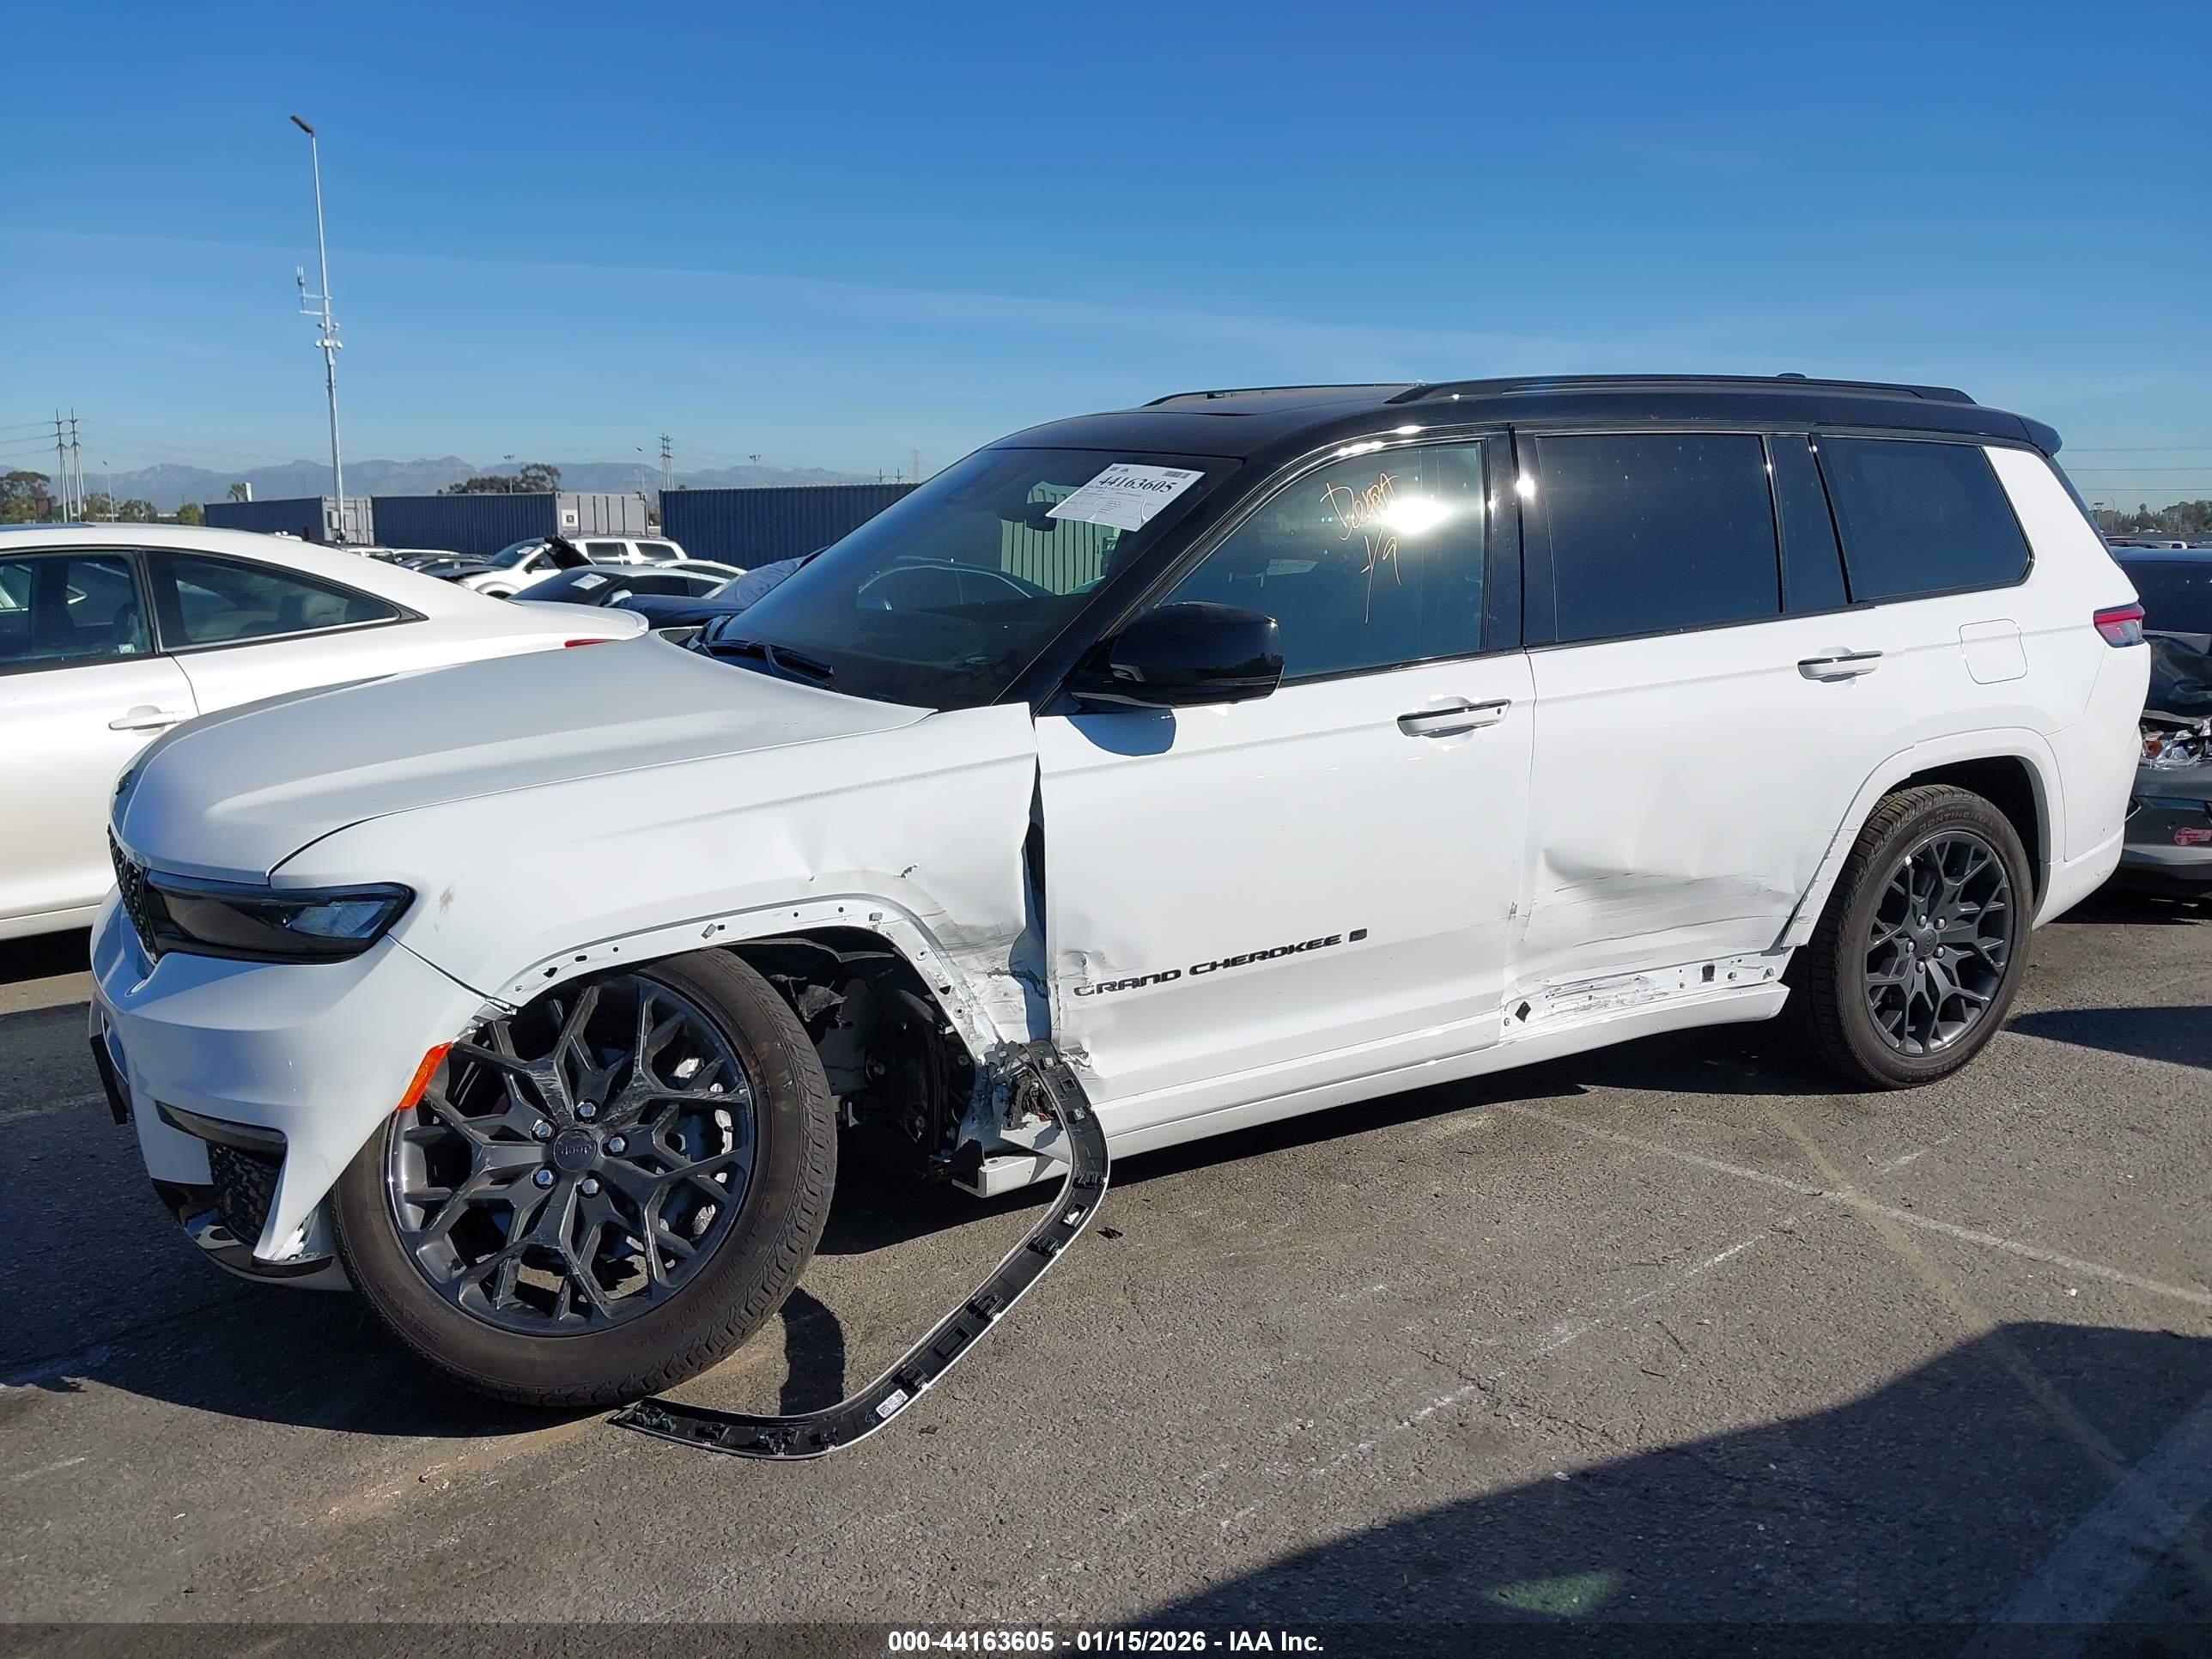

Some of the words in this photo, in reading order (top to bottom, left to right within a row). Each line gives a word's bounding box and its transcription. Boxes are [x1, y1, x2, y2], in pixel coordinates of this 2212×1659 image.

[1099, 476, 1177, 493] 44163605
[1073, 969, 1181, 996] GRAND
[1188, 934, 1341, 976] CHEROKEE
